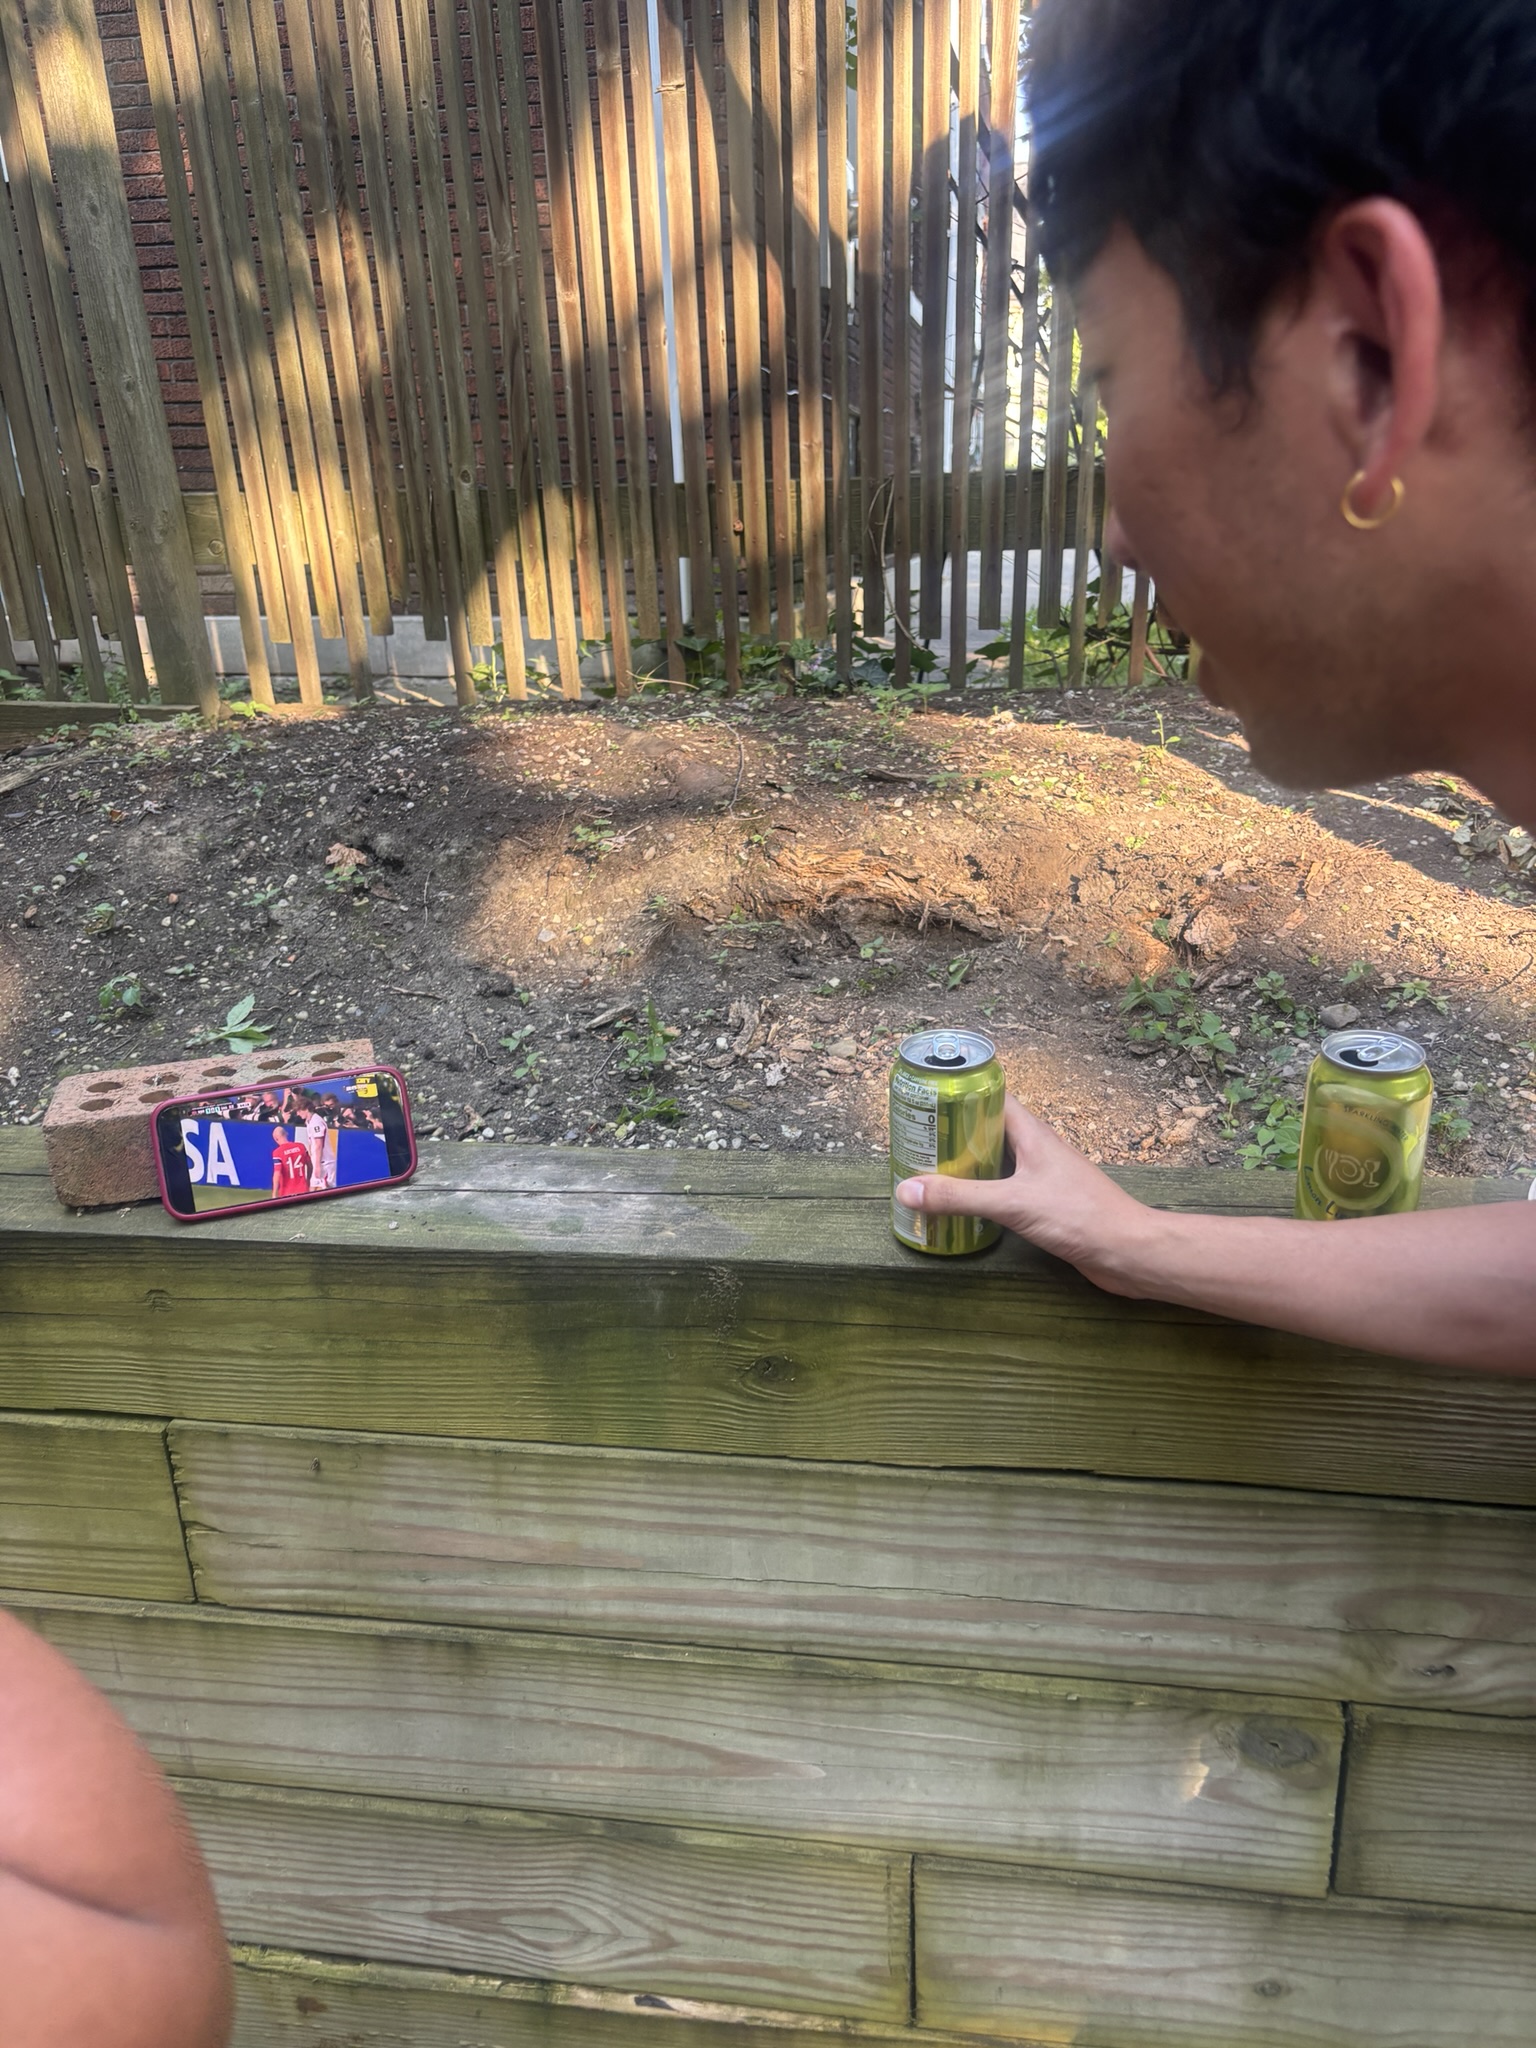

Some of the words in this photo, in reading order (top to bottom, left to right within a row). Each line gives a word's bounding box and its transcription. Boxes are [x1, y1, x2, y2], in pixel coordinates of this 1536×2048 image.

[917, 1085, 937, 1096] Facts
[927, 1114, 936, 1124] 0
[181, 1118, 241, 1186] SA
[286, 1154, 304, 1179] 14
